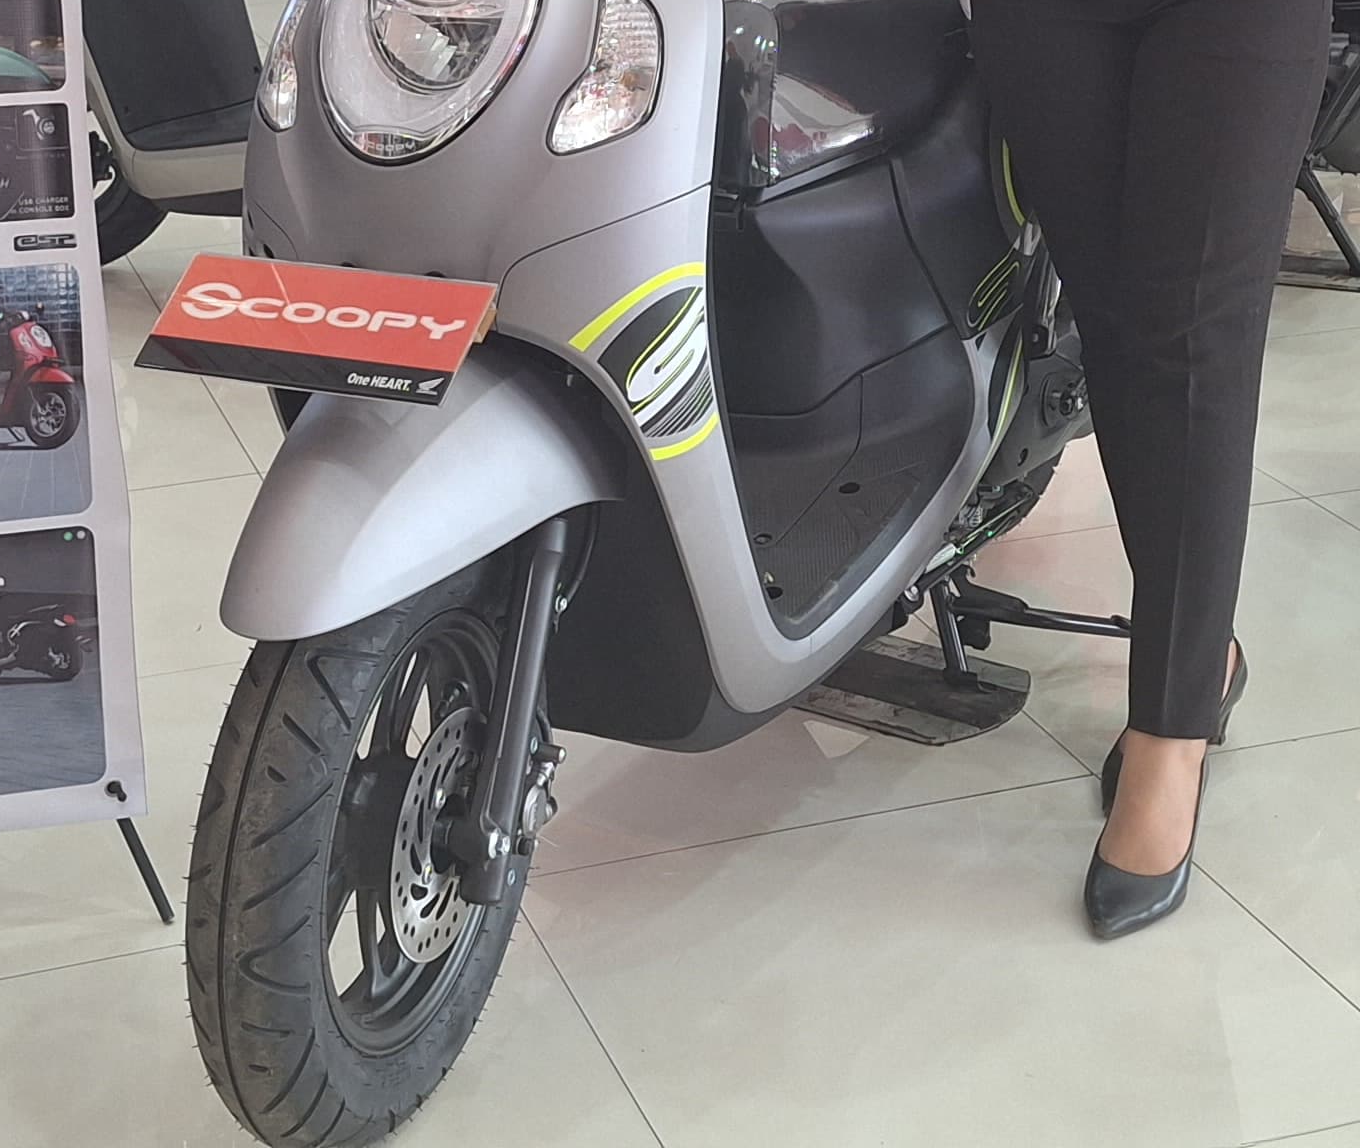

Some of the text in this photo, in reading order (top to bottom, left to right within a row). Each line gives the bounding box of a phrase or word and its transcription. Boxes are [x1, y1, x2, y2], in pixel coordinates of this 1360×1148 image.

[181, 282, 467, 340] SCOOPY
[346, 372, 413, 392] One HEART.
